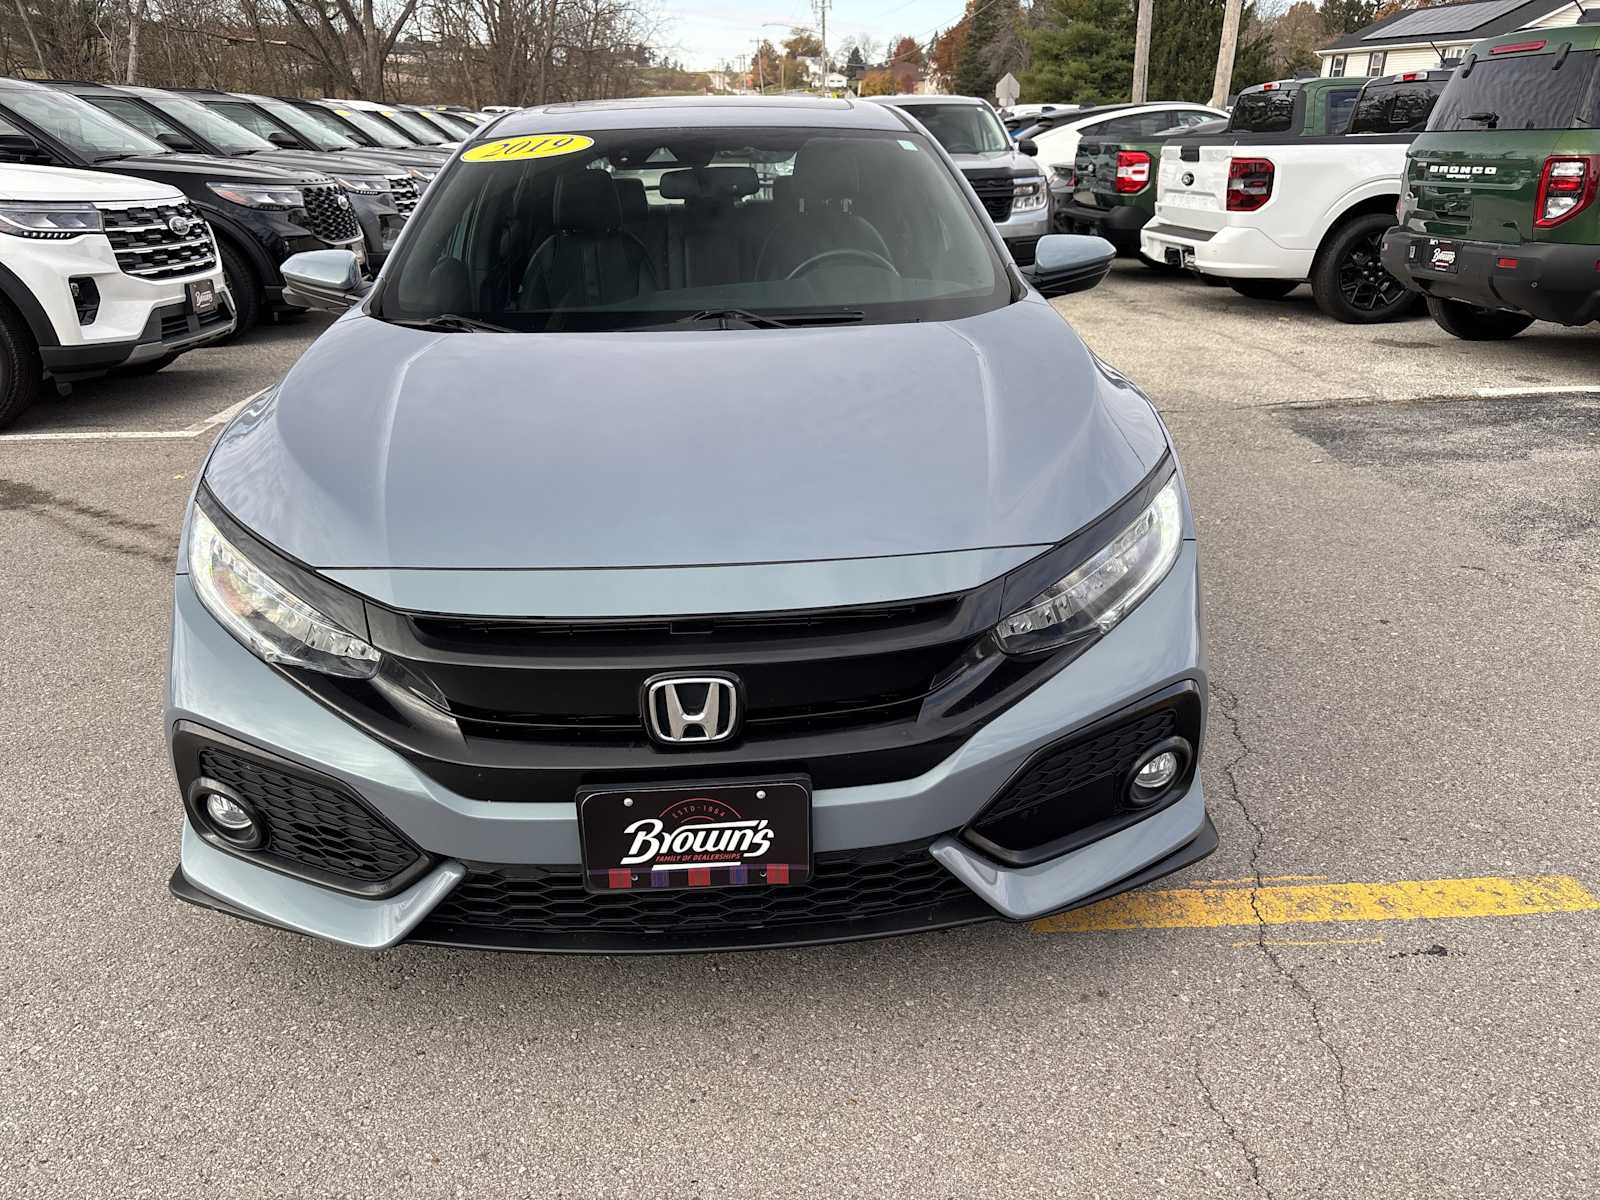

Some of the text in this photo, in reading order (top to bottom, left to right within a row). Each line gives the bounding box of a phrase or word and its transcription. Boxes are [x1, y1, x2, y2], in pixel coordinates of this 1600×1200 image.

[481, 137, 574, 158] 2019
[1429, 165, 1497, 175] BRONCO
[620, 818, 774, 864] Brown's
[655, 852, 740, 863] FAMILY OF DEALERSHIPS
